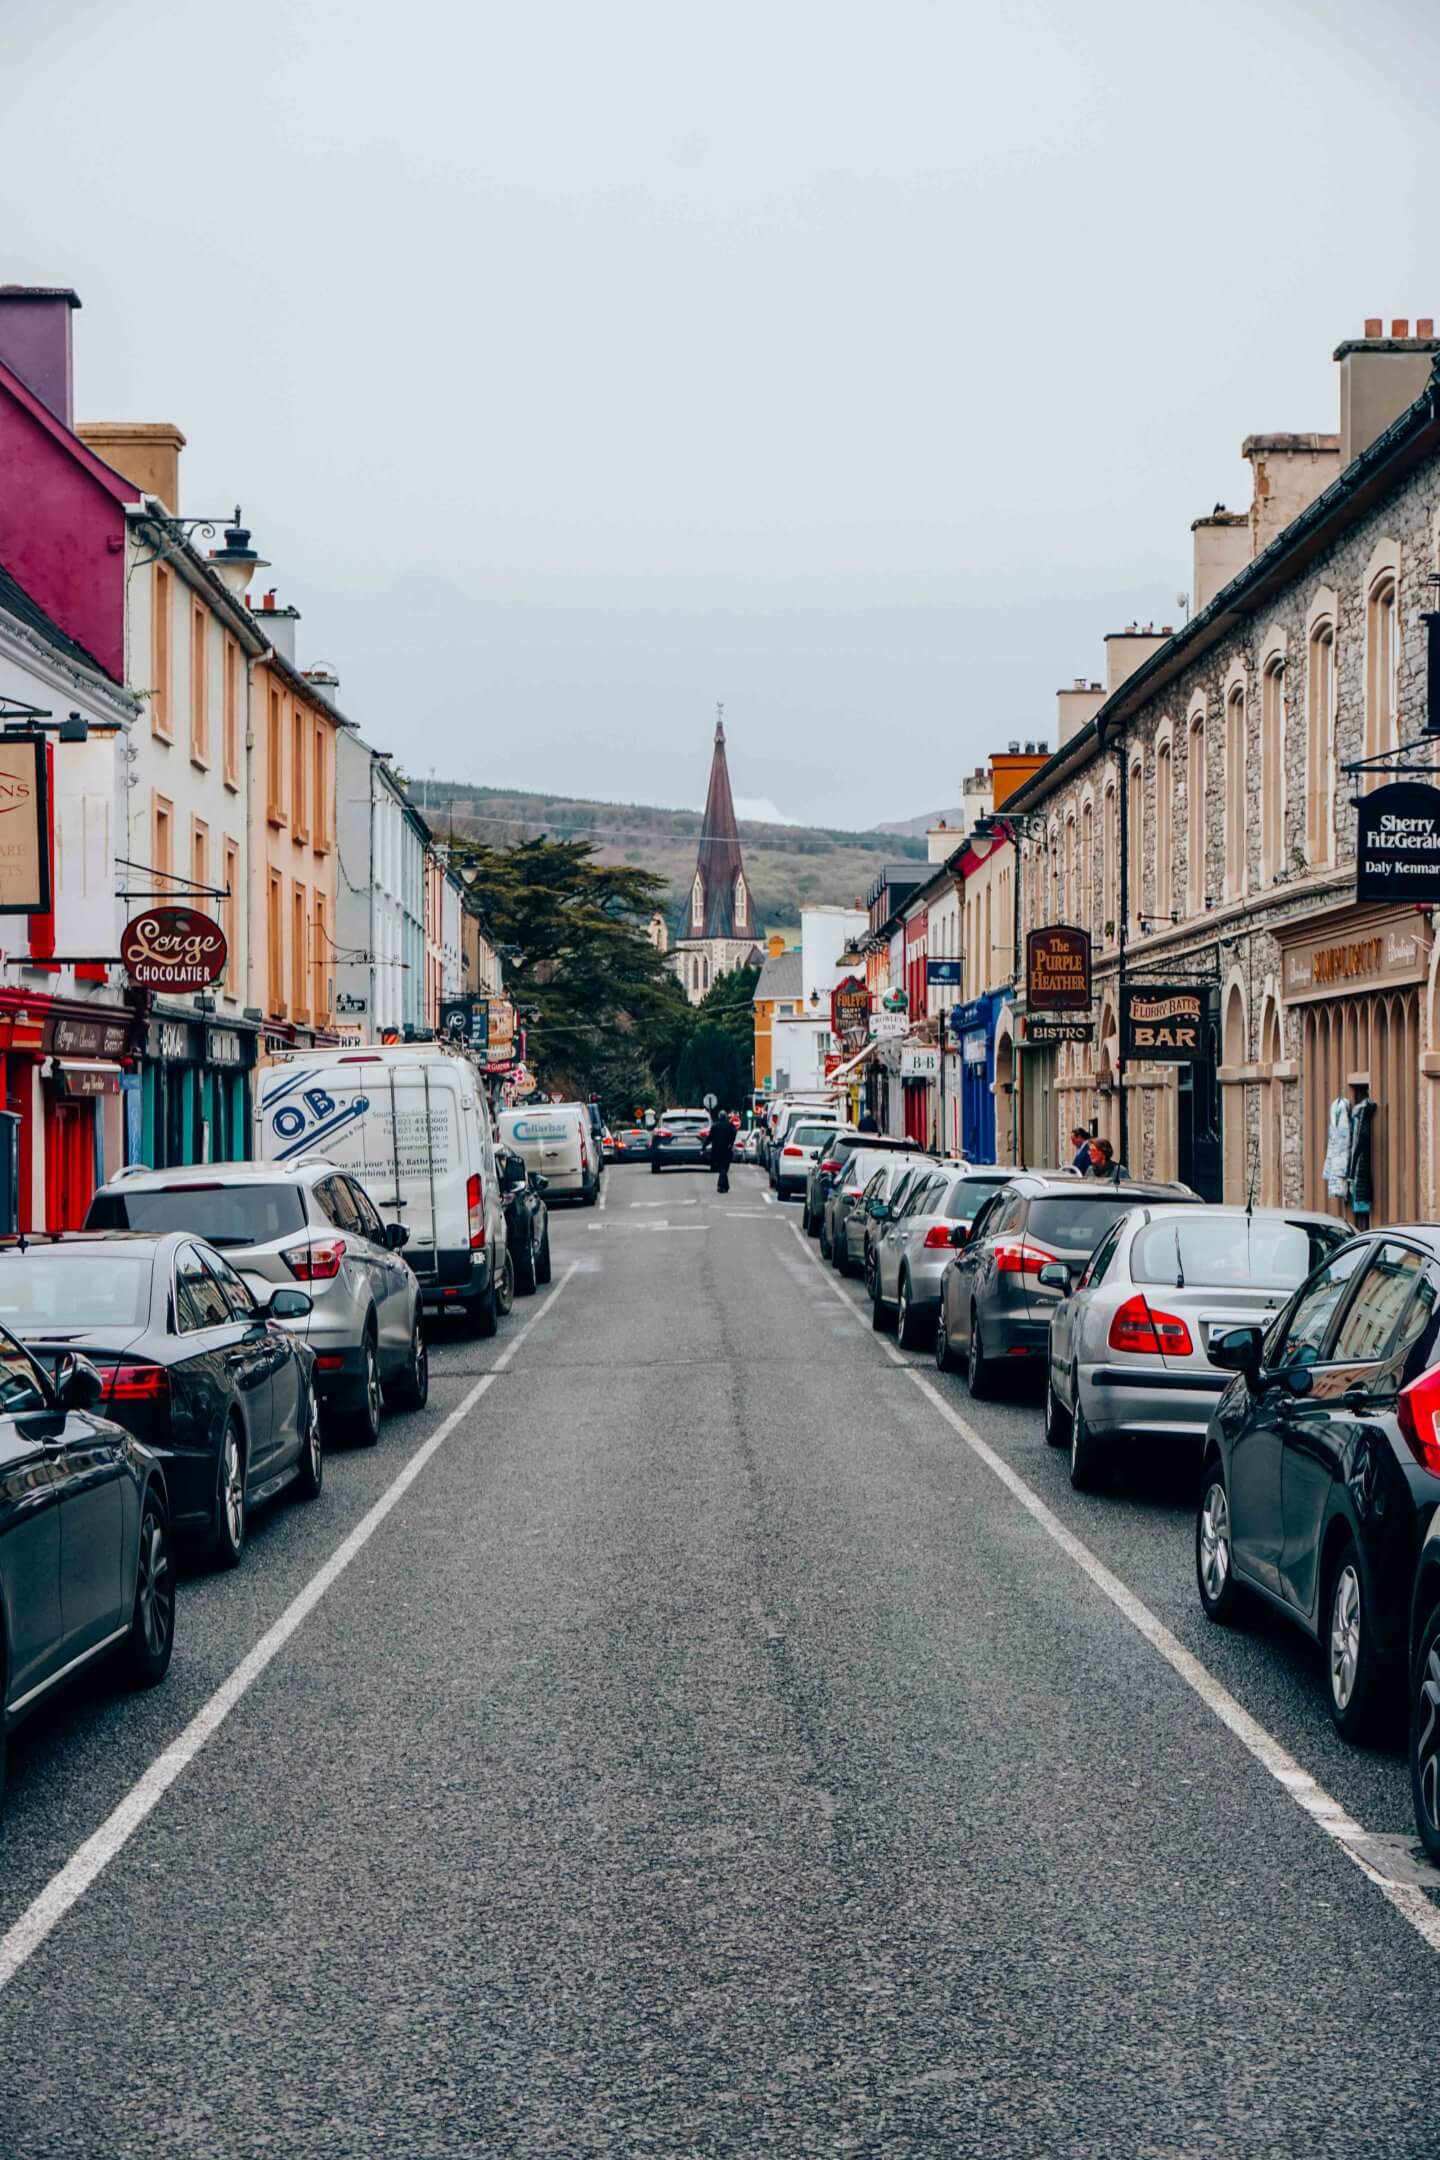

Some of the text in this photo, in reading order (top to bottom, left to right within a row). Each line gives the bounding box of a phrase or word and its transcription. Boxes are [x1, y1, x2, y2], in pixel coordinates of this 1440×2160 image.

[1380, 814, 1435, 836] Sherry
[1365, 861, 1393, 877] Daly
[127, 919, 222, 965] Lorge
[1050, 939, 1069, 952] The
[1035, 950, 1082, 971] PURPLE
[136, 964, 210, 981] CHOCOLATIER
[1032, 972, 1087, 990] HEATHER
[1133, 1003, 1167, 1018] FLORRY
[1033, 1027, 1086, 1039] BISTRO
[1135, 1028, 1196, 1047] BAR
